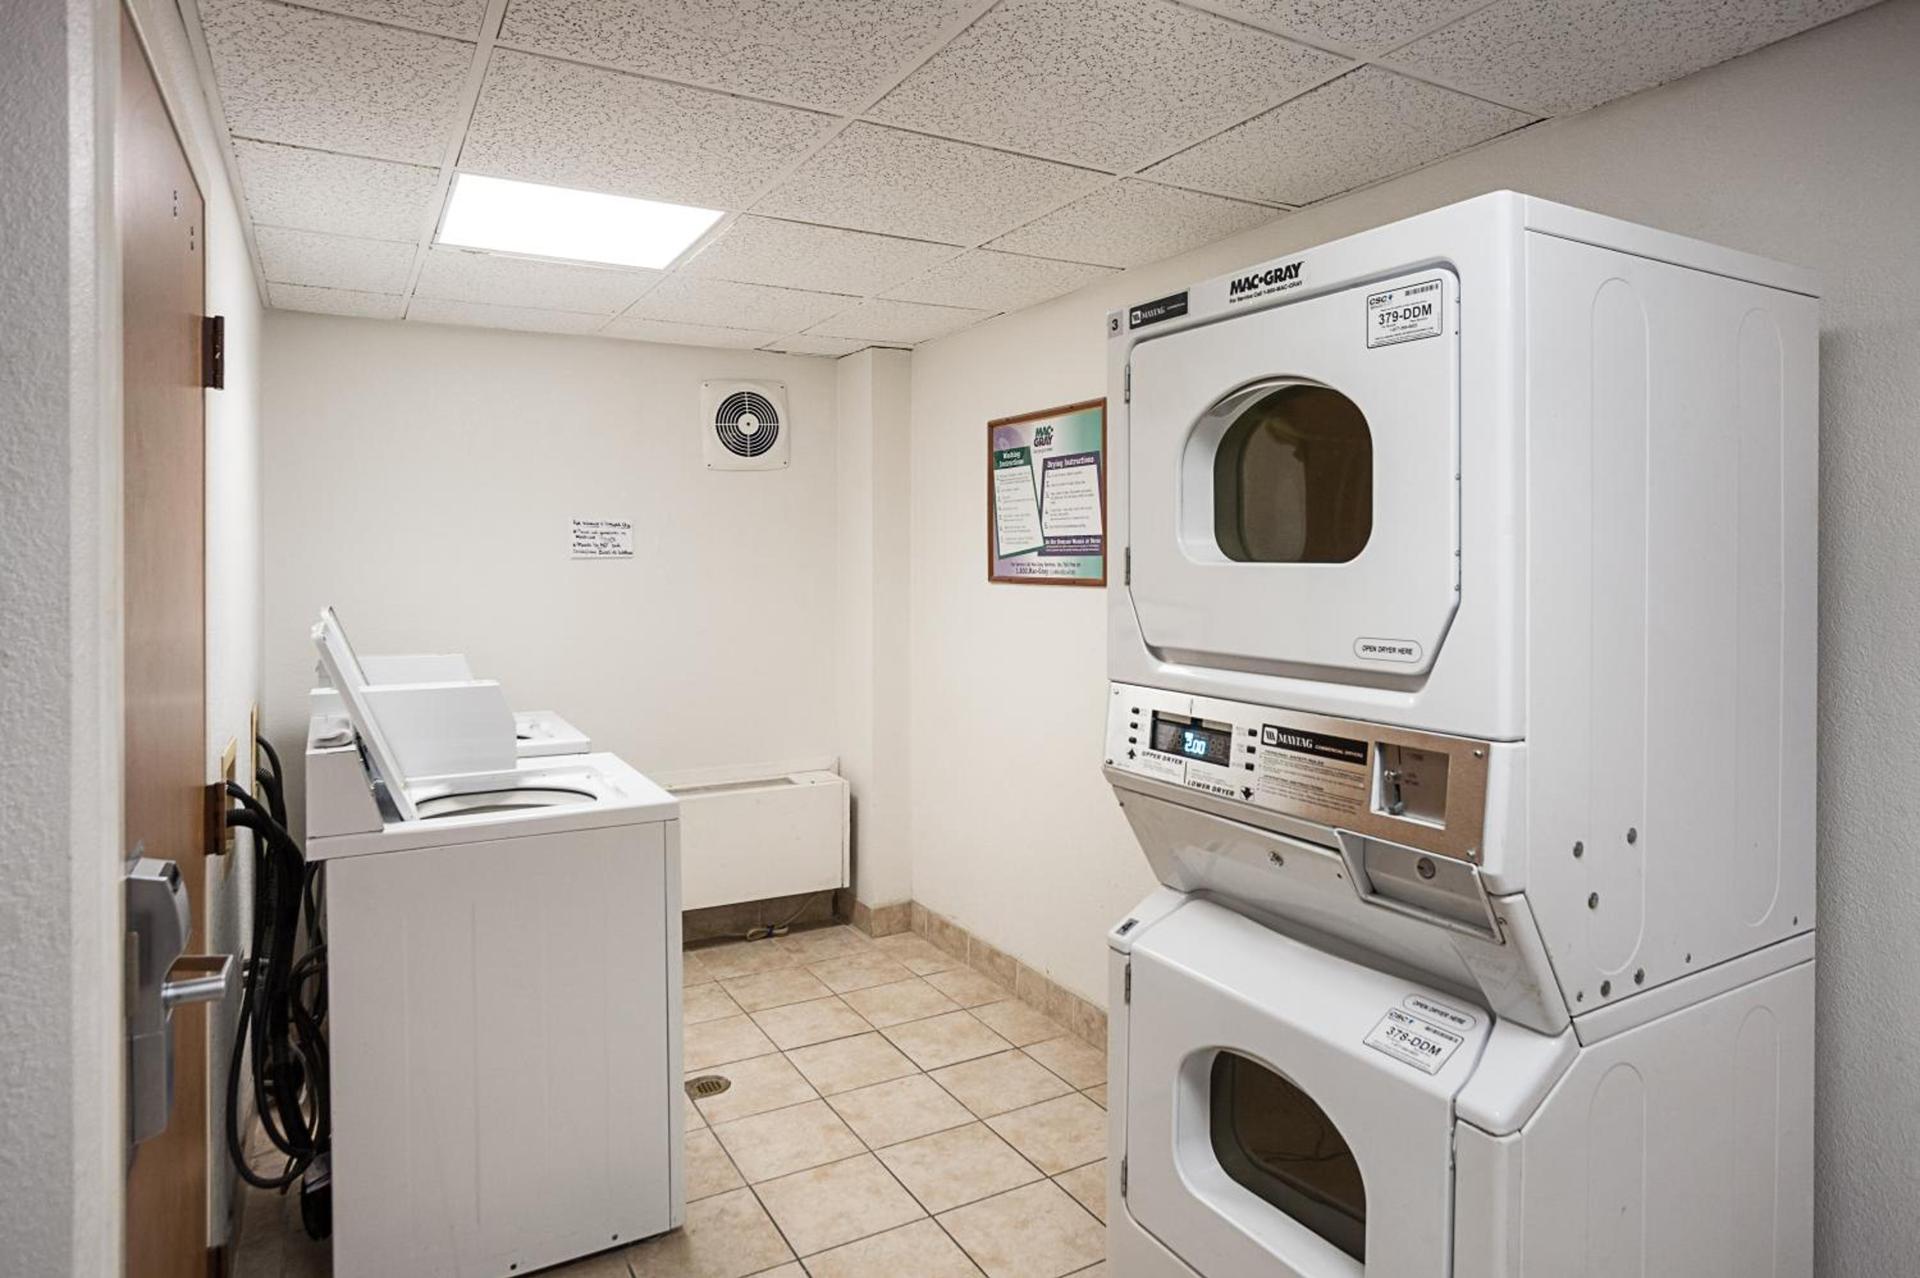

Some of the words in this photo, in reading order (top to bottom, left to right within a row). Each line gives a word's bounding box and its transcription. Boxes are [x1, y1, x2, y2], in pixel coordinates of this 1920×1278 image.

[1378, 303, 1432, 325] 379-DDM
[1111, 318, 1119, 331] 3
[1033, 435, 1054, 447] GRAY
[1377, 646, 1396, 654] DRYER
[1398, 647, 1413, 655] HERE
[1278, 732, 1313, 749] MAYTAG
[1142, 751, 1161, 759] UPPER
[1162, 755, 1183, 764] DRYER
[1187, 780, 1211, 791] LOWER
[1211, 785, 1235, 797] DRYER
[1386, 1026, 1442, 1056] 378-DDM
